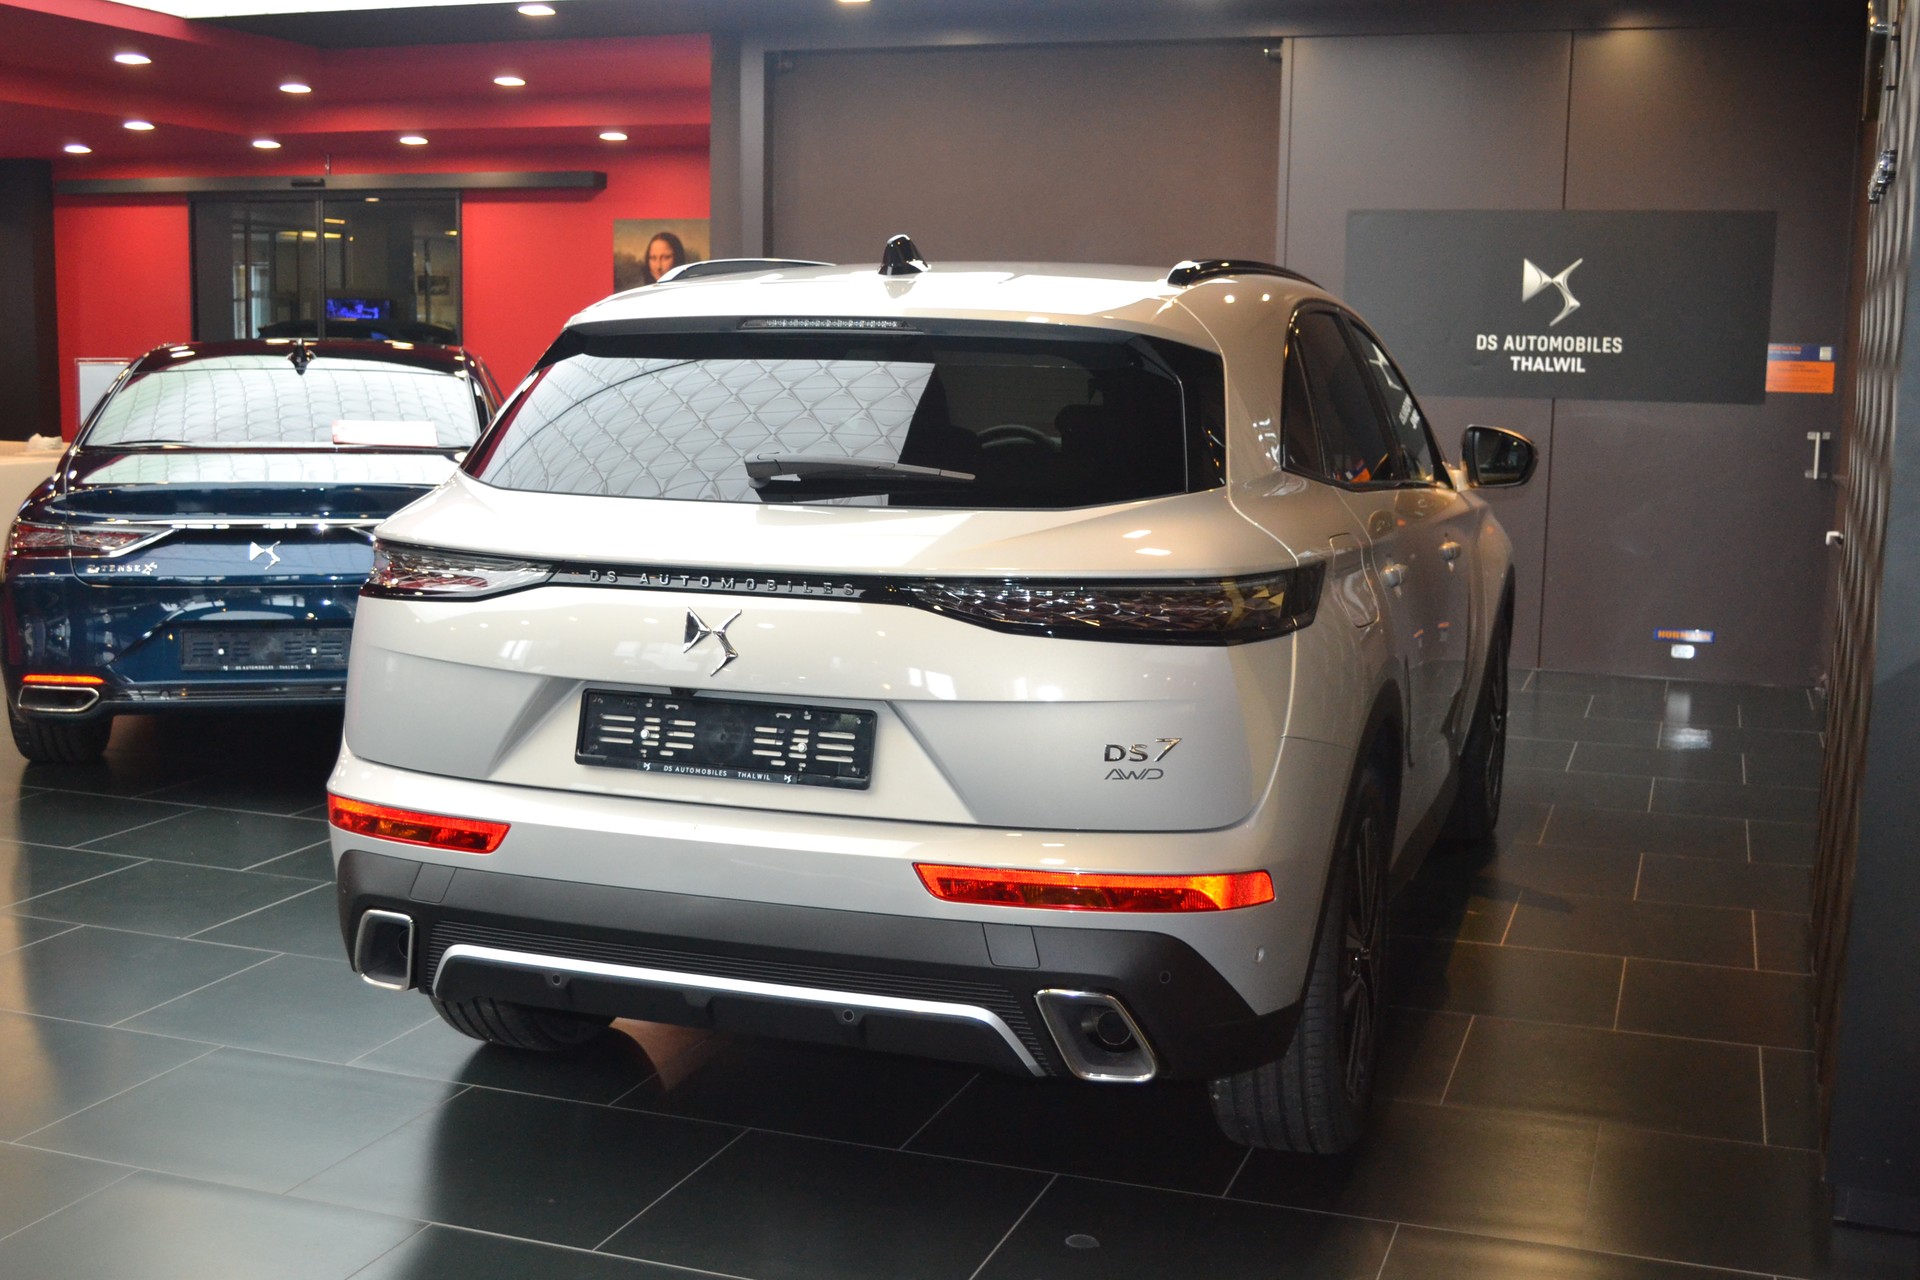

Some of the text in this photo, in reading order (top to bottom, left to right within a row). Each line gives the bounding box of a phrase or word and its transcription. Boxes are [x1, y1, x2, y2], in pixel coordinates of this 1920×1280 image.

[1475, 334, 1623, 353] DS AUTOMOBILES
[1510, 356, 1586, 373] THALWIL
[589, 569, 855, 596] DS AUTOMOBILES
[675, 766, 727, 777] AUTOMOBILES
[738, 771, 771, 781] THALWIL
[1104, 768, 1164, 780] AWD
